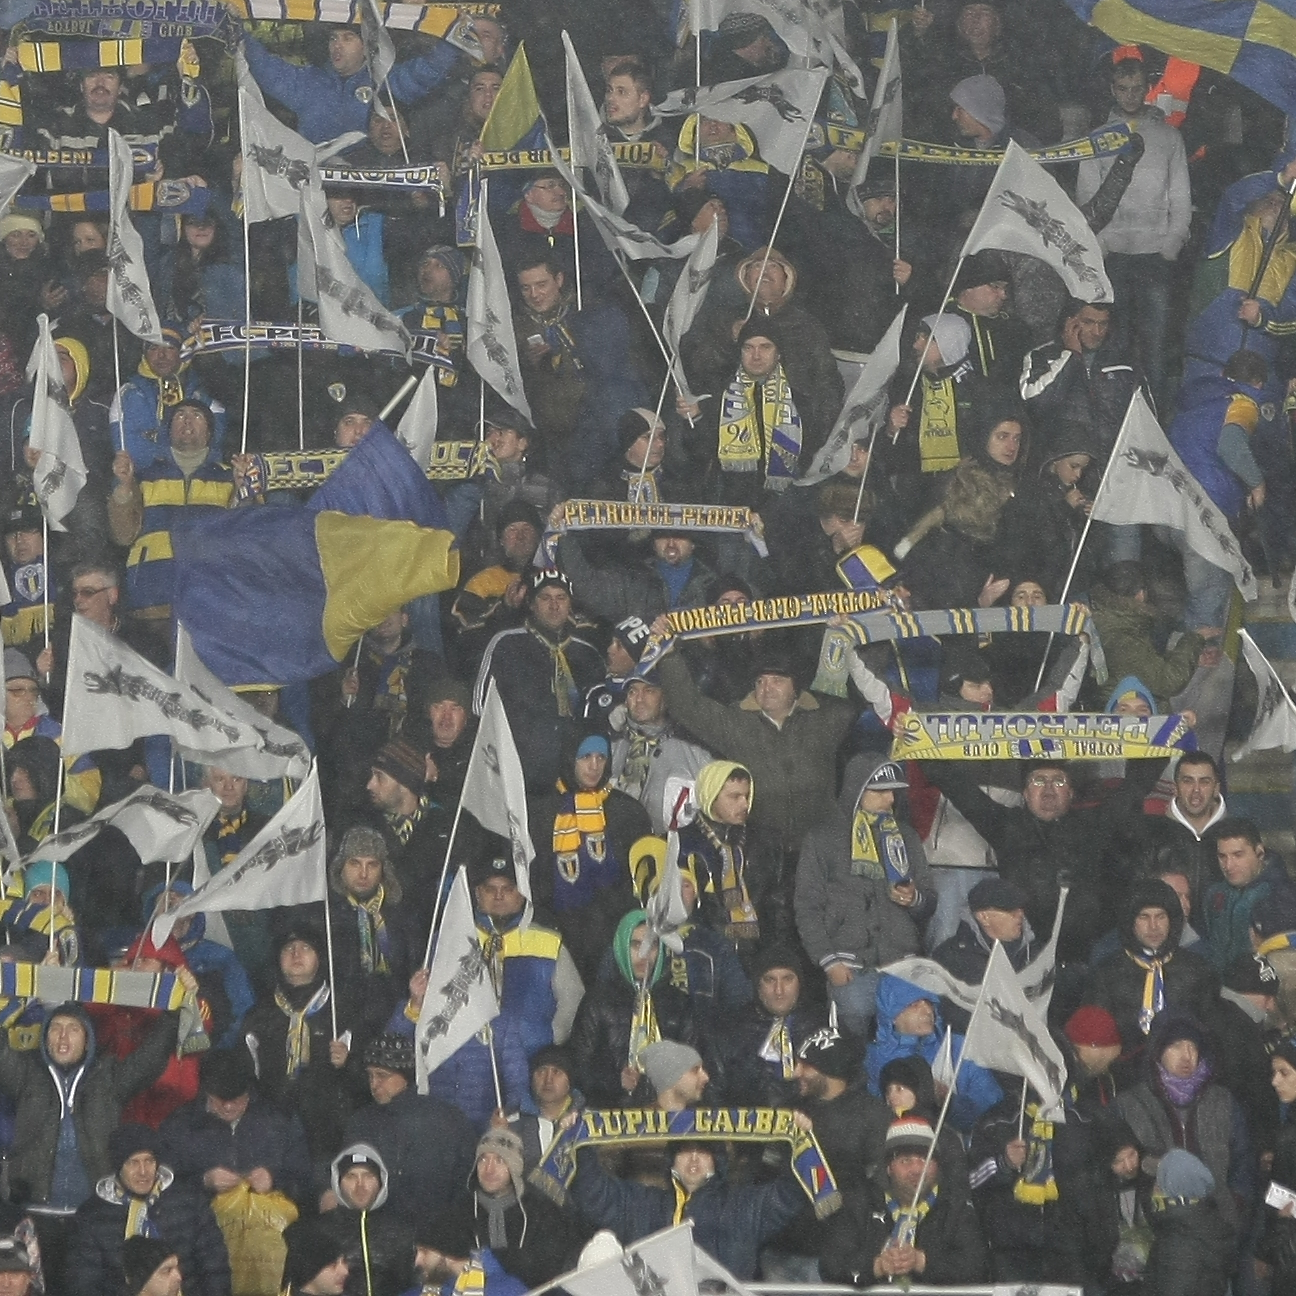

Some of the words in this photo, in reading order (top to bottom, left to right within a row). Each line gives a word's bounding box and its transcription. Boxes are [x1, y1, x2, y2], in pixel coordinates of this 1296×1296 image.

[563, 501, 673, 526] PETROLUL
[753, 595, 803, 623] CLUB
[926, 714, 1149, 746] PETROLUL
[962, 740, 1000, 757] CLUB
[1073, 740, 1124, 758] FOTBAL
[583, 1108, 670, 1139] LUPII
